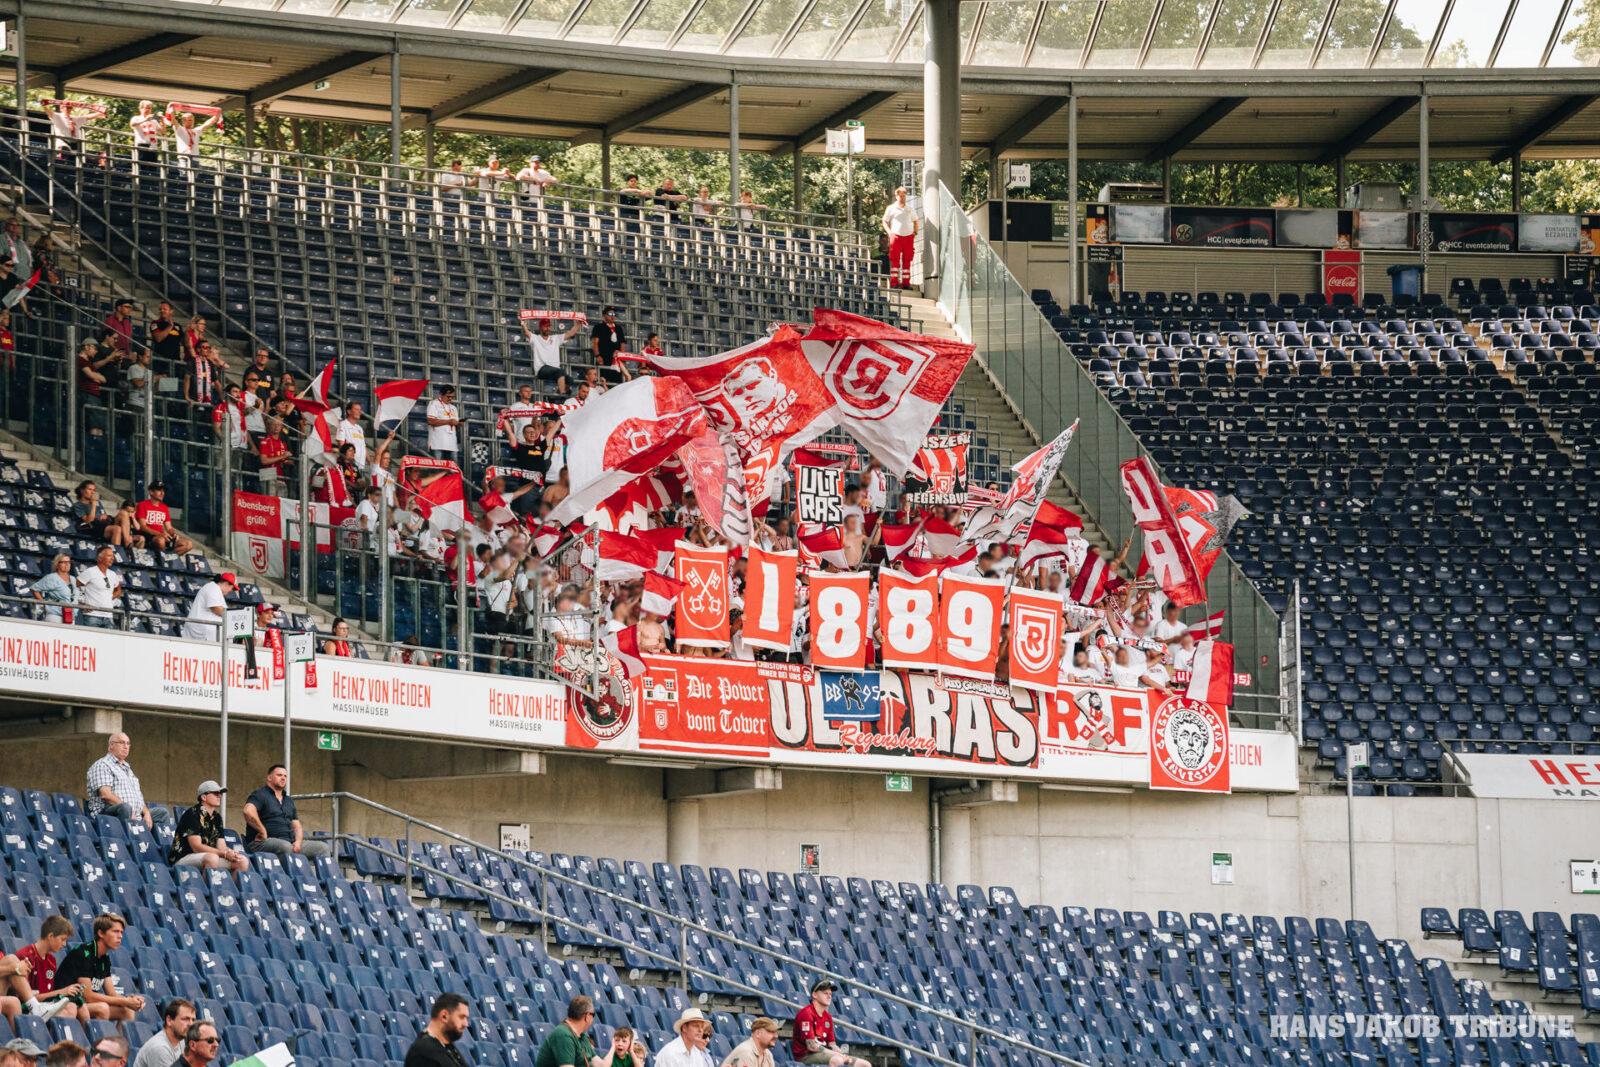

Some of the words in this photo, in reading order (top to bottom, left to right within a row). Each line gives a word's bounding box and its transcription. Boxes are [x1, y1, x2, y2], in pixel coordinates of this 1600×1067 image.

[1225, 237, 1269, 245] eventcatering
[1465, 242, 1510, 250] eventcatering
[237, 498, 275, 516] Abensberg
[246, 514, 267, 526] grüßt
[234, 622, 240, 631] S
[240, 622, 245, 630] 6
[26, 640, 49, 667] VON
[53, 639, 96, 673] HEIDEN
[295, 647, 300, 655] S
[301, 646, 306, 655] 7
[163, 651, 199, 684] HEINZ
[202, 660, 223, 686] VON
[228, 659, 270, 692] HEIEN
[757, 661, 788, 671] CHRISTOPH
[788, 673, 801, 681] UNS
[333, 671, 366, 701] HEINZ
[369, 679, 390, 704] VON
[393, 676, 431, 709] HEIDEN
[684, 674, 713, 699] Die
[717, 676, 765, 705] Power
[824, 683, 842, 702] BB
[332, 703, 389, 717] MASSIVHÄUSER
[489, 688, 519, 717] HEINZ
[521, 695, 542, 719] VON
[489, 719, 542, 732] MASSIVHÄUSER
[687, 710, 717, 732] vom
[719, 708, 766, 735] Tower
[838, 724, 938, 758] Regensburg
[503, 833, 513, 841] WC
[1573, 869, 1585, 877] WC
